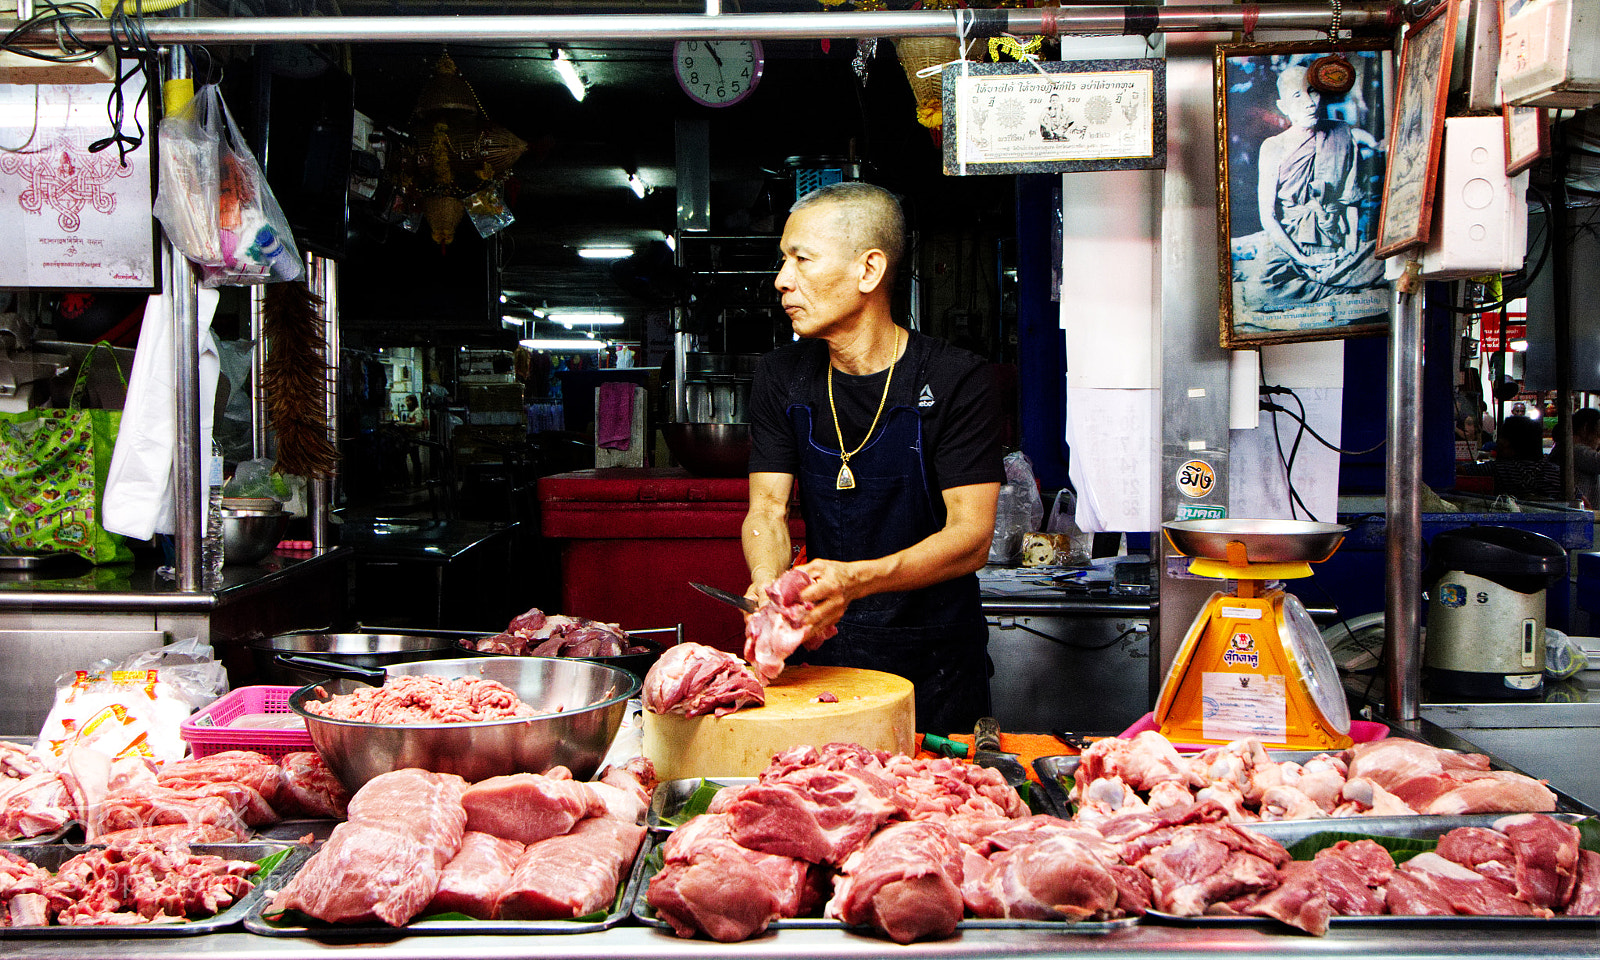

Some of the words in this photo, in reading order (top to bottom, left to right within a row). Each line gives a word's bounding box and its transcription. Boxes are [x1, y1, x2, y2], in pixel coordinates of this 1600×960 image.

[684, 57, 693, 68] 9
[745, 51, 754, 63] 3
[690, 72, 699, 84] 8
[741, 67, 749, 78] 4
[703, 84, 710, 94] 7
[717, 86, 726, 97] 6
[731, 81, 740, 93] 5
[1224, 649, 1258, 667] ตุ๊กตาคู่
